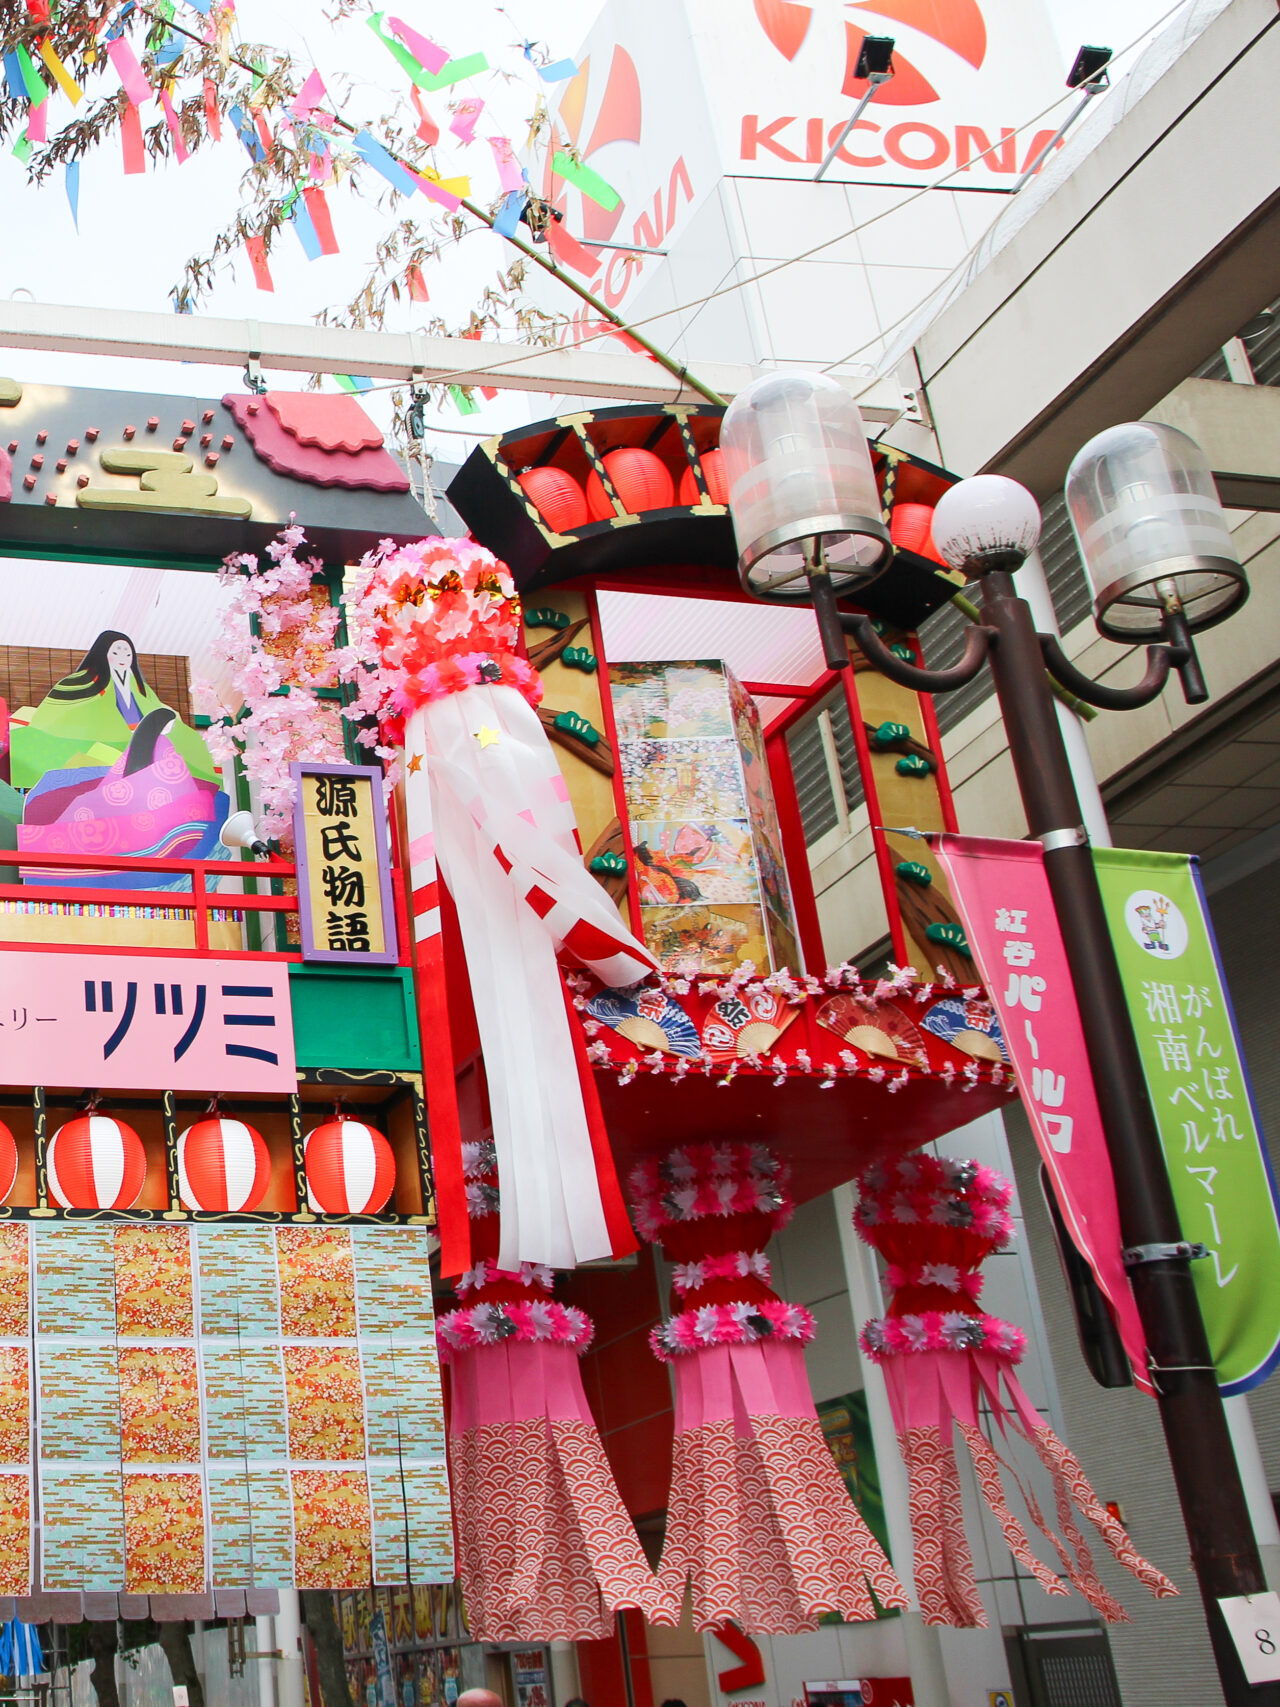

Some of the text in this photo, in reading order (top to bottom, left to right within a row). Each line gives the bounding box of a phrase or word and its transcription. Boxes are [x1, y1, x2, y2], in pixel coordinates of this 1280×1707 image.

[740, 114, 1065, 175] KICONA
[315, 776, 371, 953] 源氏物語
[84, 980, 279, 1066] ツツミ
[1181, 985, 1244, 1142] がんばれ
[1141, 980, 1238, 1288] 湘南ベルマーレ
[1255, 1628, 1276, 1655] 8
